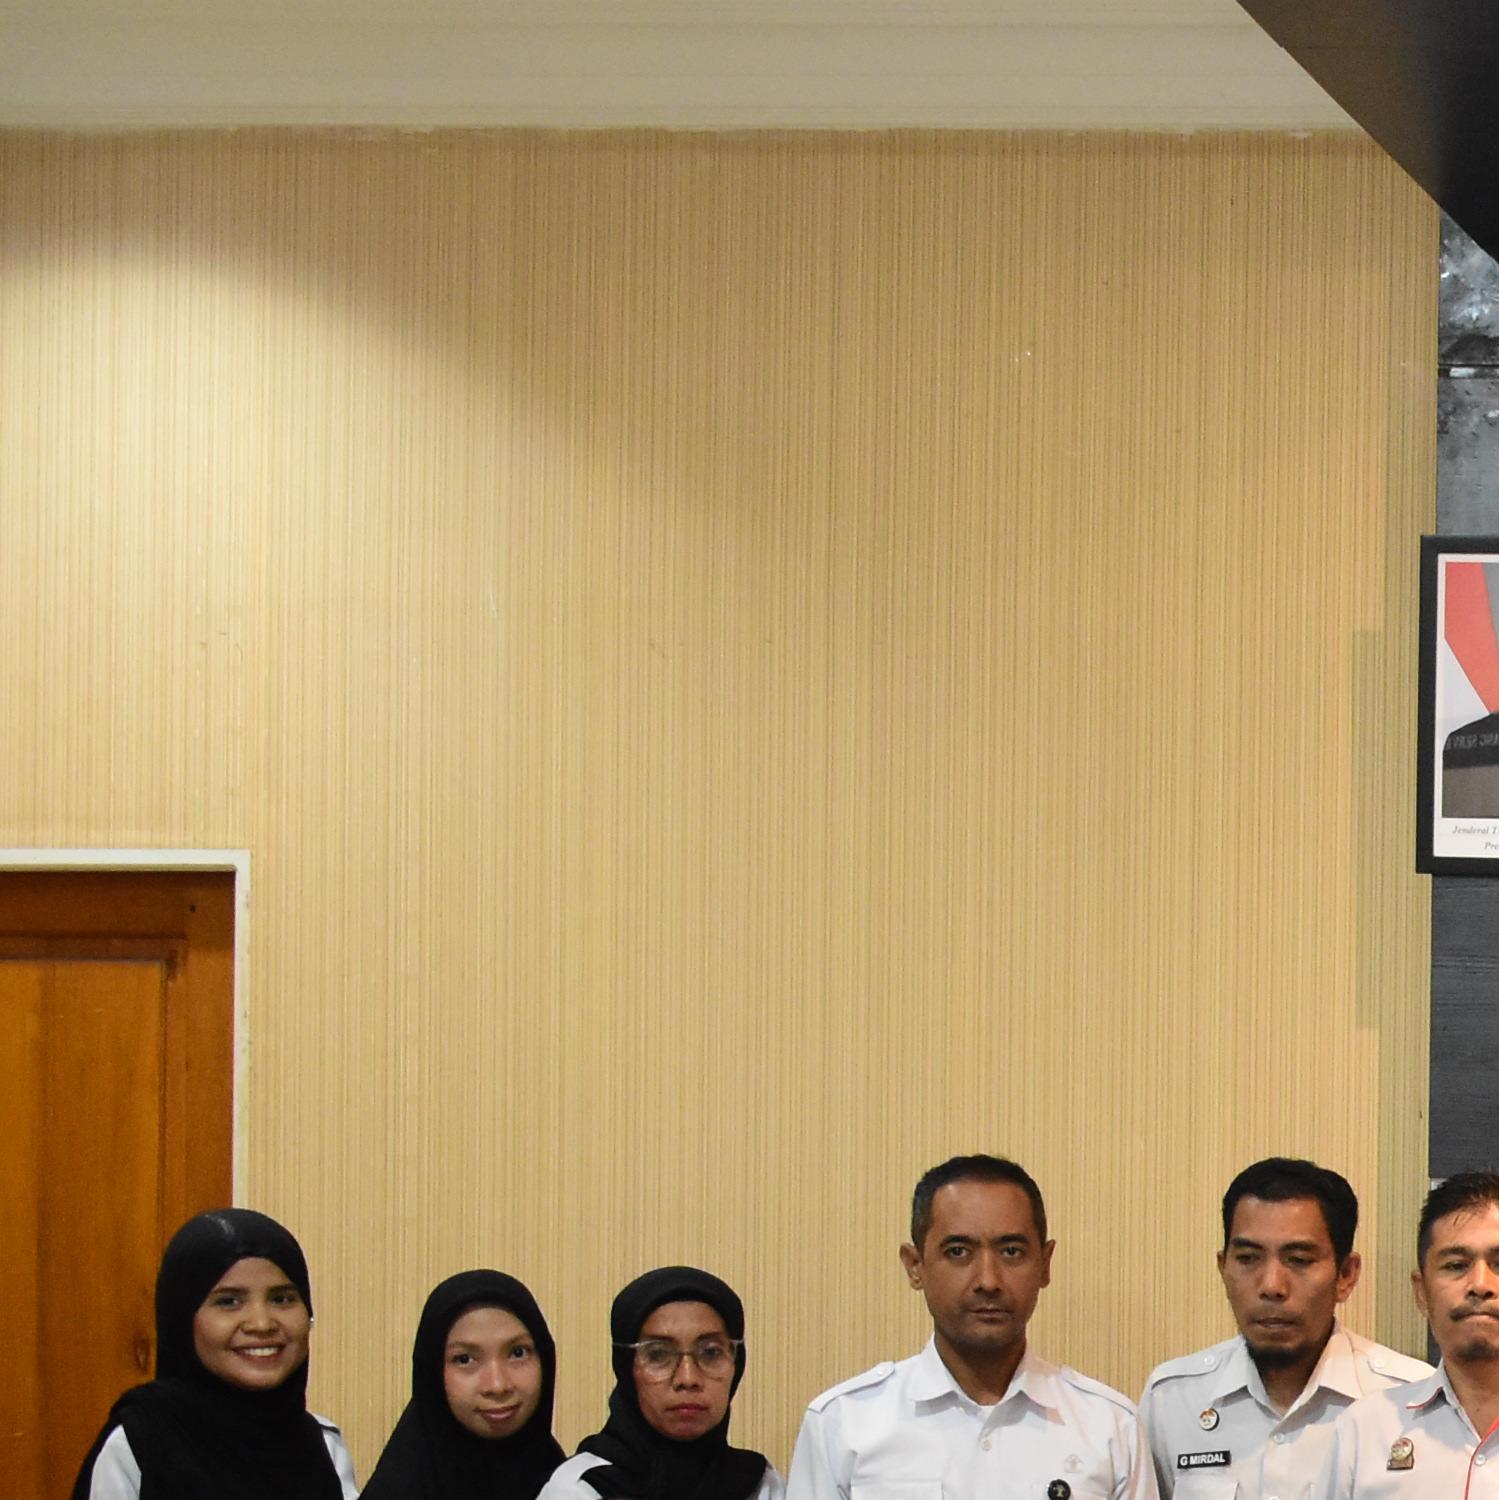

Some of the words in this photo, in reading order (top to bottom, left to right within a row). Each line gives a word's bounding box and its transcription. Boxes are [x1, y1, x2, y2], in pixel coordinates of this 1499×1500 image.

[1451, 825, 1489, 835] Jenderal
[1180, 1455, 1188, 1466] G
[1190, 1453, 1226, 1465] MIRDAL
